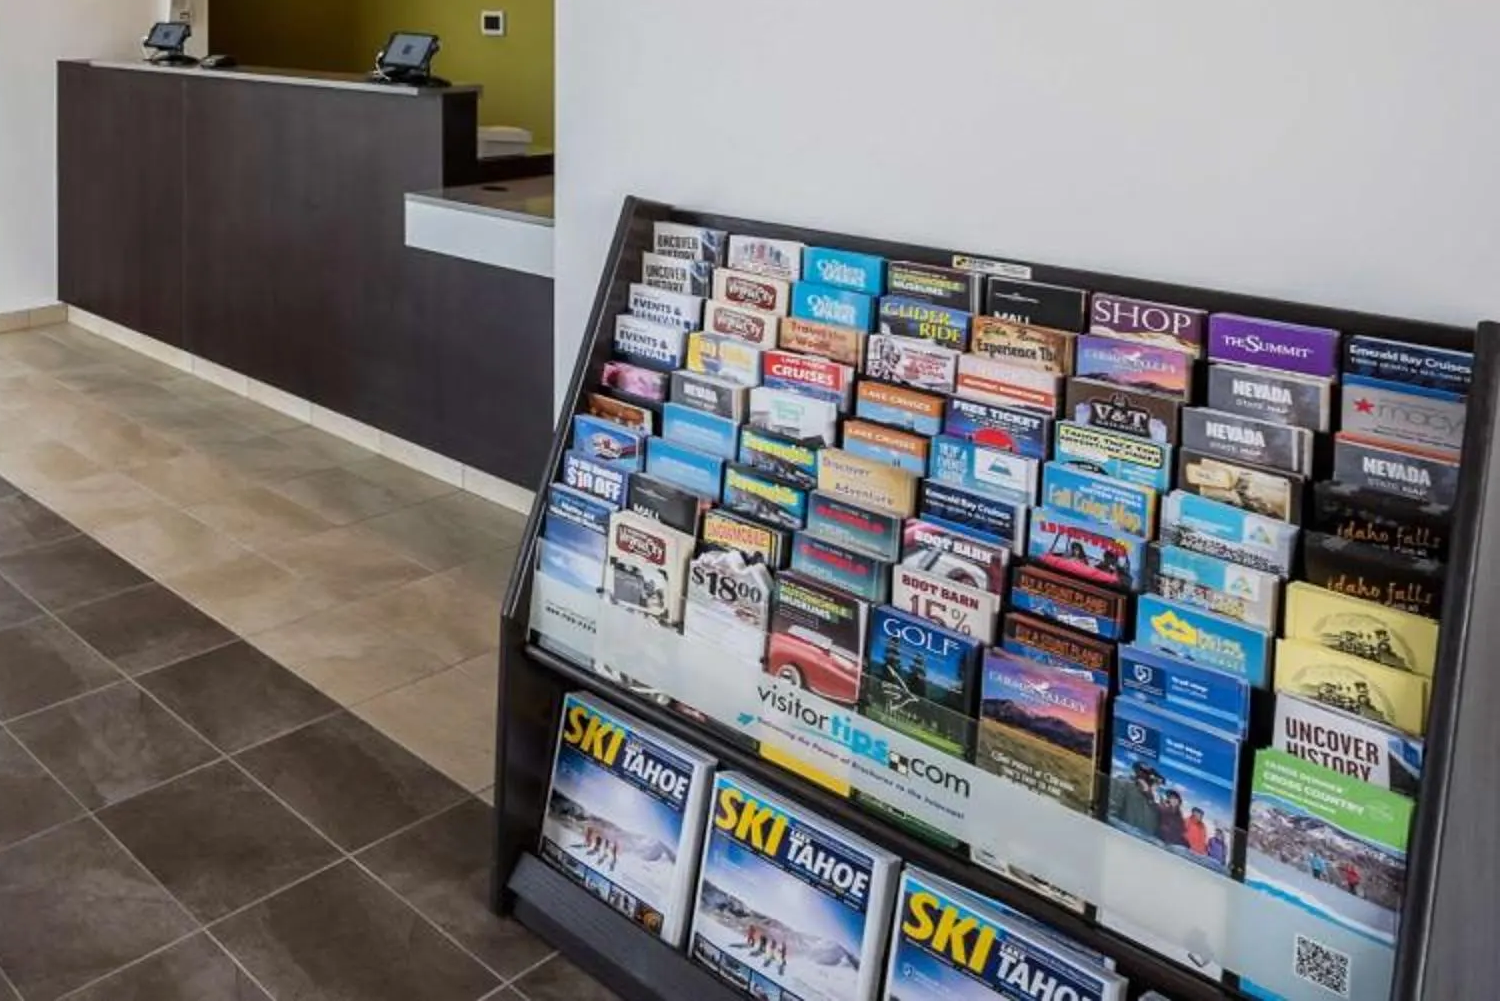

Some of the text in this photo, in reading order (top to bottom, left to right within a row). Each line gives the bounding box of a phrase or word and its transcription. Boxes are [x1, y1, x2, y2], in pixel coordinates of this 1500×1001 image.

[884, 302, 950, 326] GLIDER
[1094, 299, 1191, 336] SHOP
[919, 322, 960, 343] RIDE
[1222, 334, 1310, 359] THE SUMMIT
[772, 364, 834, 387] CRUISES
[1349, 344, 1398, 362] Emerald
[1400, 352, 1423, 368] Bay
[1425, 357, 1472, 375] Cruises
[1232, 379, 1293, 404] NEVADA
[953, 398, 989, 417] FREE
[991, 408, 1042, 430] TICKET
[1092, 402, 1148, 431] V&T
[1206, 420, 1266, 447] NEVADA
[1363, 456, 1431, 487] NEVADA
[595, 477, 621, 501] OFF
[914, 529, 994, 564] BOOT BARN
[1336, 521, 1389, 542] idaho
[902, 574, 980, 610] BOOT BARN
[883, 618, 960, 656] GOLF
[563, 705, 626, 767] SKI
[1285, 716, 1380, 766] UNCOVER
[621, 748, 690, 799] TAHOE
[812, 742, 840, 760] Power
[852, 761, 894, 788] Brochures
[908, 786, 922, 800] the
[715, 787, 789, 857] SKI
[786, 835, 869, 897] TAHOE
[902, 892, 997, 973] SKI
[996, 951, 1094, 1001] TAHO
